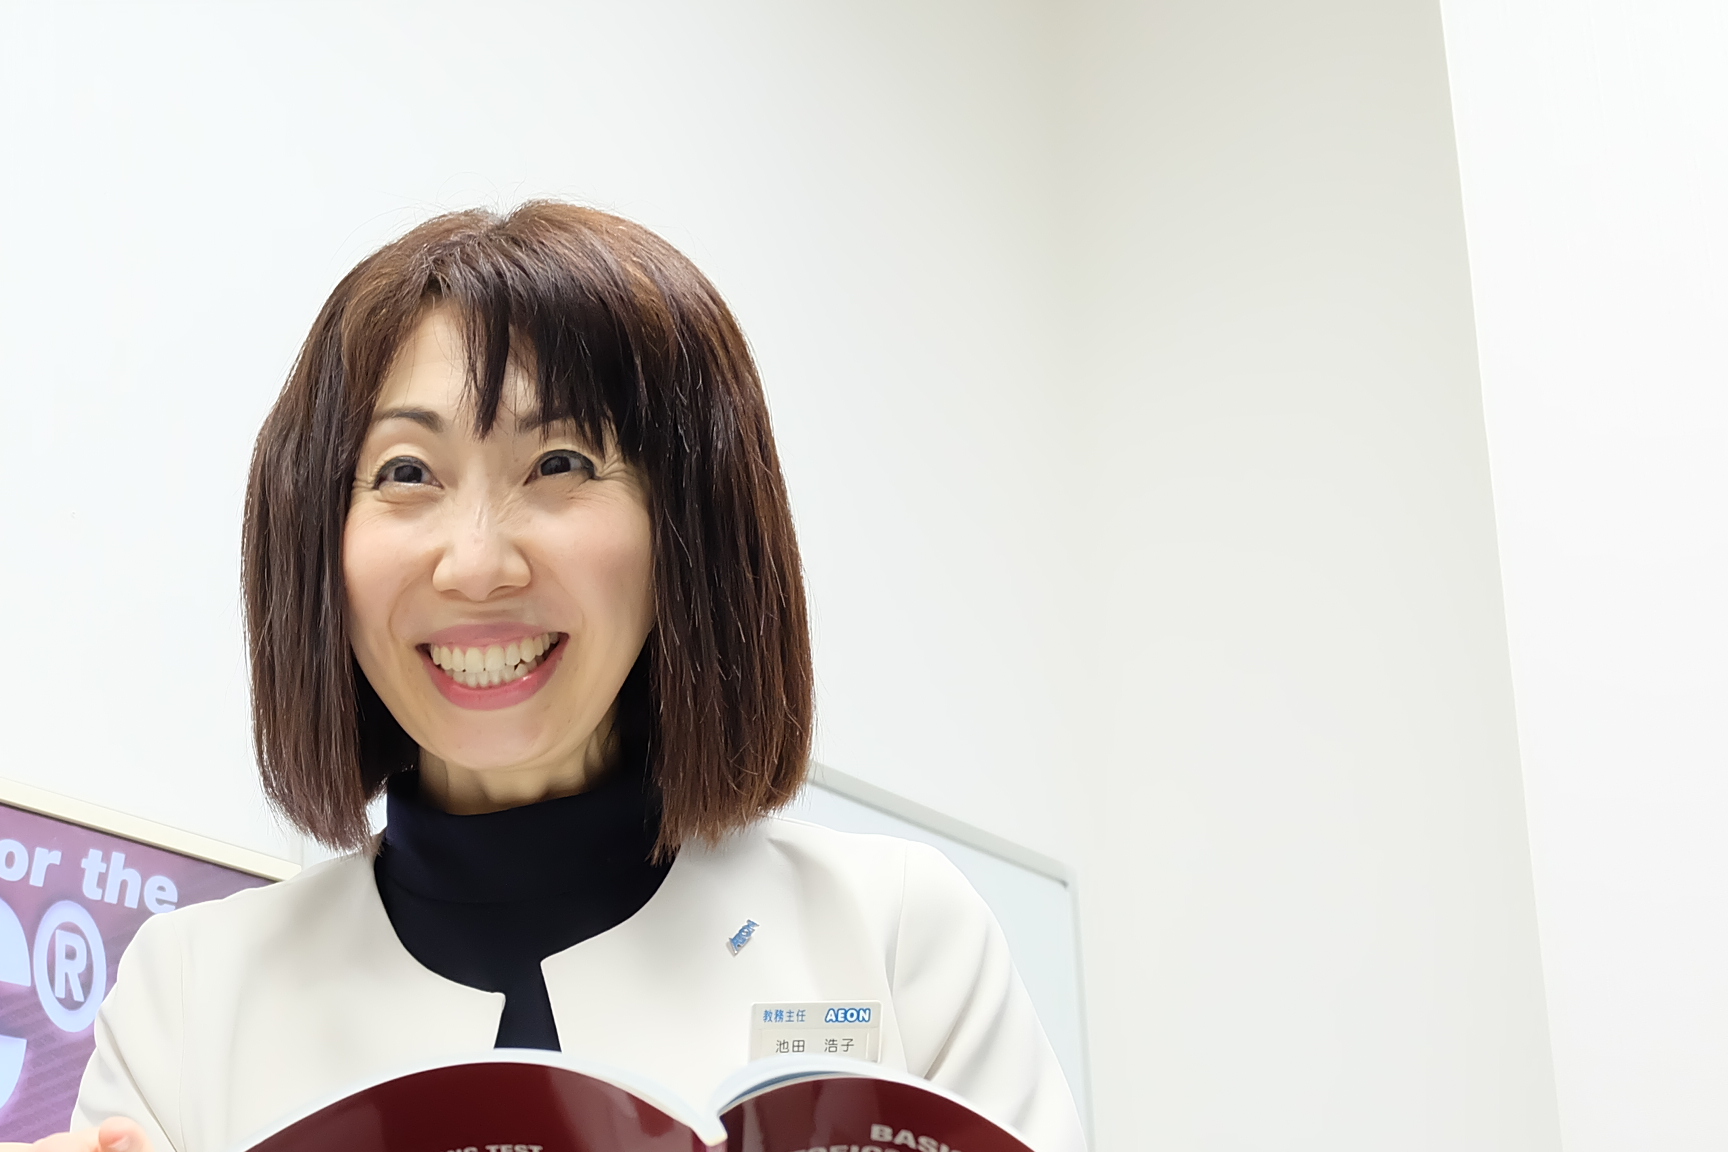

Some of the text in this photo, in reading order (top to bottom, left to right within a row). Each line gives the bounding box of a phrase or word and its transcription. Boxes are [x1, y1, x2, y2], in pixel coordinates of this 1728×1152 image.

[81, 848, 178, 914] the
[762, 1009, 806, 1023] 教務主任
[824, 1008, 871, 1023] AEON
[775, 1038, 855, 1053] 池田 浩子
